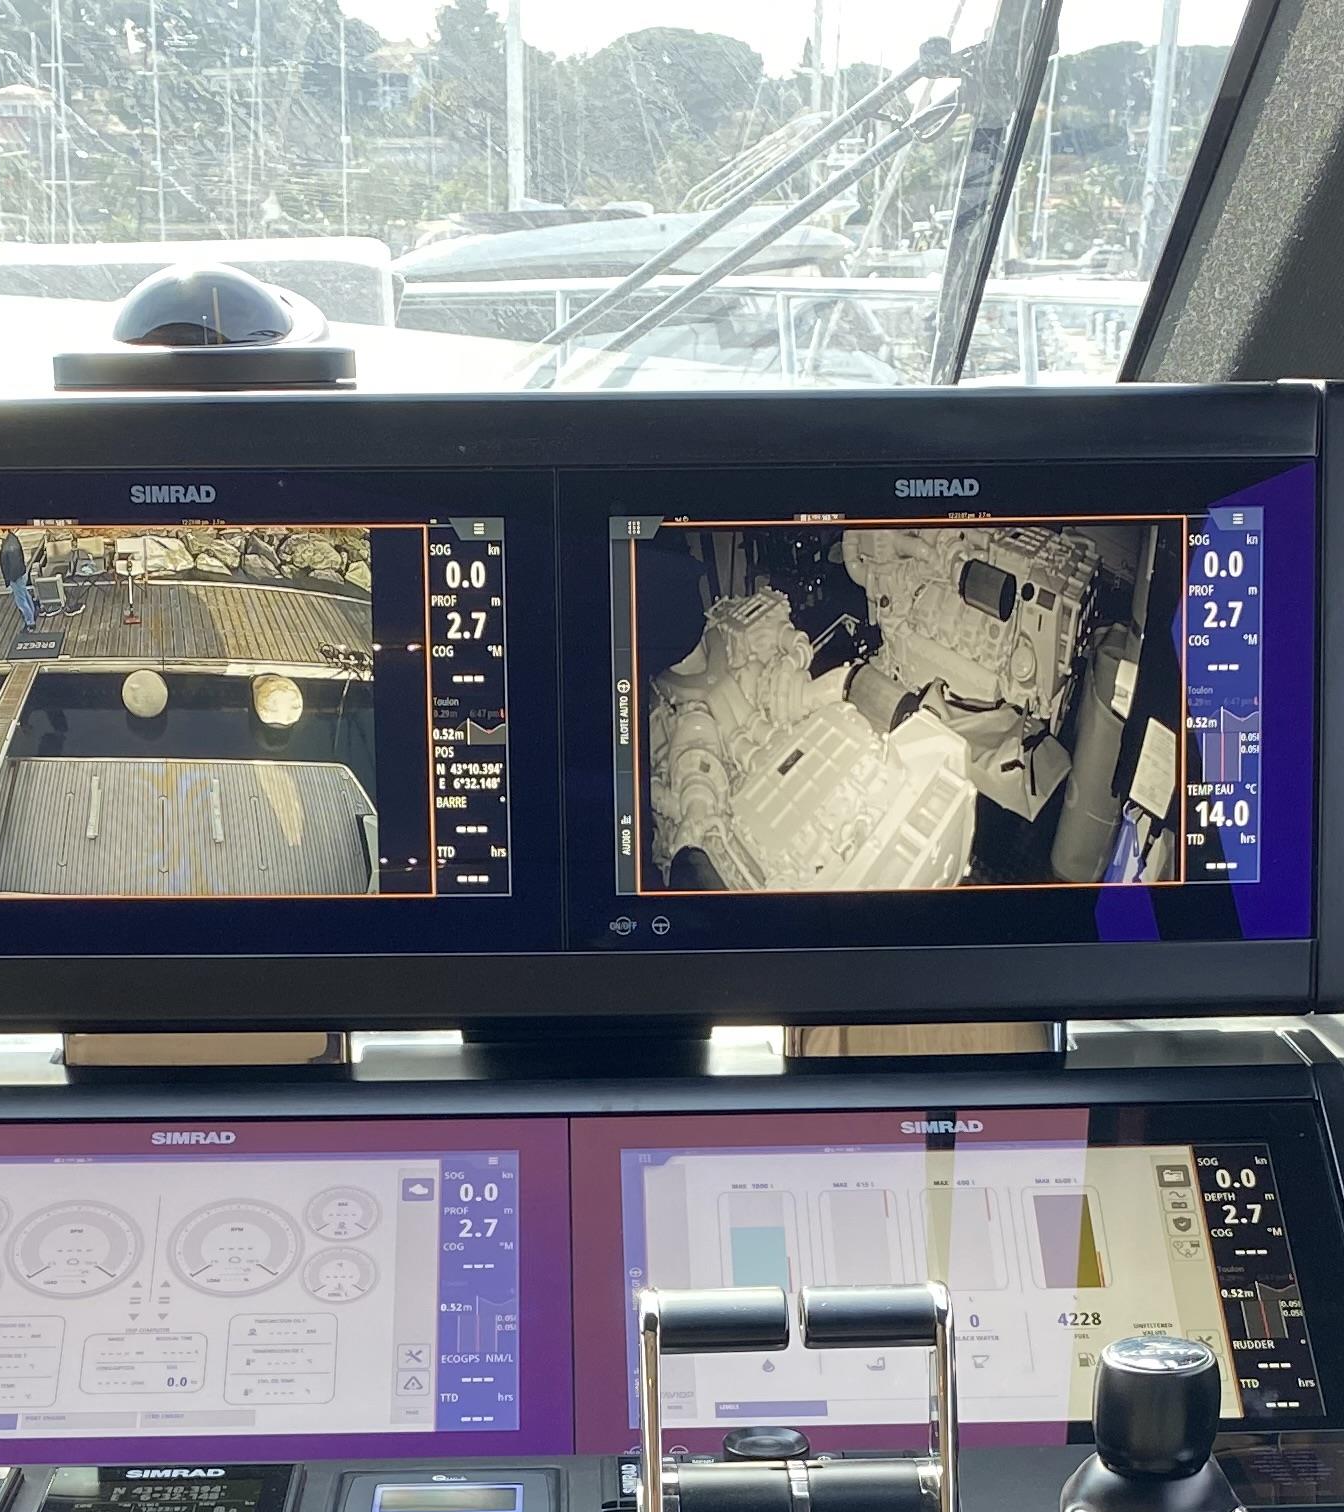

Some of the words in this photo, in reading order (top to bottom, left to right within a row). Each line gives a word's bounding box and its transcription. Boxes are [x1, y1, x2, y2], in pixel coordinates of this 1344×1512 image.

[130, 485, 216, 504] SIMRAD
[894, 479, 980, 498] SIMRAD
[1188, 534, 1210, 546] SOG
[1246, 533, 1258, 545] kn
[429, 543, 452, 556] SOG
[487, 543, 500, 556] kn
[1203, 550, 1244, 578] 0.0
[445, 560, 486, 589] 0.0
[1188, 584, 1214, 597] PROF
[431, 594, 457, 607] PROF
[490, 596, 501, 607] m
[1203, 601, 1243, 628] 2.7
[446, 611, 487, 640] 2.7
[1188, 634, 1210, 646] COG
[432, 645, 454, 658] COG
[619, 695, 629, 716] AUTO
[434, 746, 455, 758] POS
[436, 763, 446, 776] N
[438, 777, 446, 790] E
[1187, 784, 1213, 796] TEMP
[1214, 784, 1234, 796] EAU
[435, 796, 468, 809] BARRE
[1194, 799, 1250, 828] 14.0
[621, 828, 631, 856] AUDIO
[1186, 833, 1205, 846] TTD
[1240, 832, 1257, 845] hrs
[436, 845, 456, 858] TTD
[490, 845, 506, 858] hrs
[900, 1120, 984, 1134] SIMRAD
[151, 1131, 236, 1145] SIMRAD
[1196, 1157, 1219, 1167] SOG
[1254, 1156, 1268, 1166] kn
[444, 1171, 465, 1180] SOG
[502, 1170, 514, 1180] kn
[1215, 1168, 1257, 1189] 0.0
[459, 1182, 499, 1202] 0.0
[1204, 1191, 1236, 1202] DEPTH
[444, 1206, 469, 1215] PROF
[1221, 1203, 1262, 1224] 2.7
[458, 1218, 499, 1238] 2.7
[1211, 1228, 1233, 1238] COG
[443, 1242, 465, 1251] COG
[969, 1314, 980, 1328] 0
[1057, 1311, 1102, 1327] 4228
[1232, 1339, 1275, 1350] RUDDER
[441, 1354, 480, 1364] ECOGPS
[486, 1353, 514, 1364] NM/L
[166, 1377, 188, 1388] 0.0
[1240, 1379, 1260, 1389] TTD
[1297, 1378, 1316, 1388] hrs
[440, 1393, 459, 1403] TTD
[497, 1392, 514, 1402] hrs
[125, 1468, 226, 1479] SIMRAD
